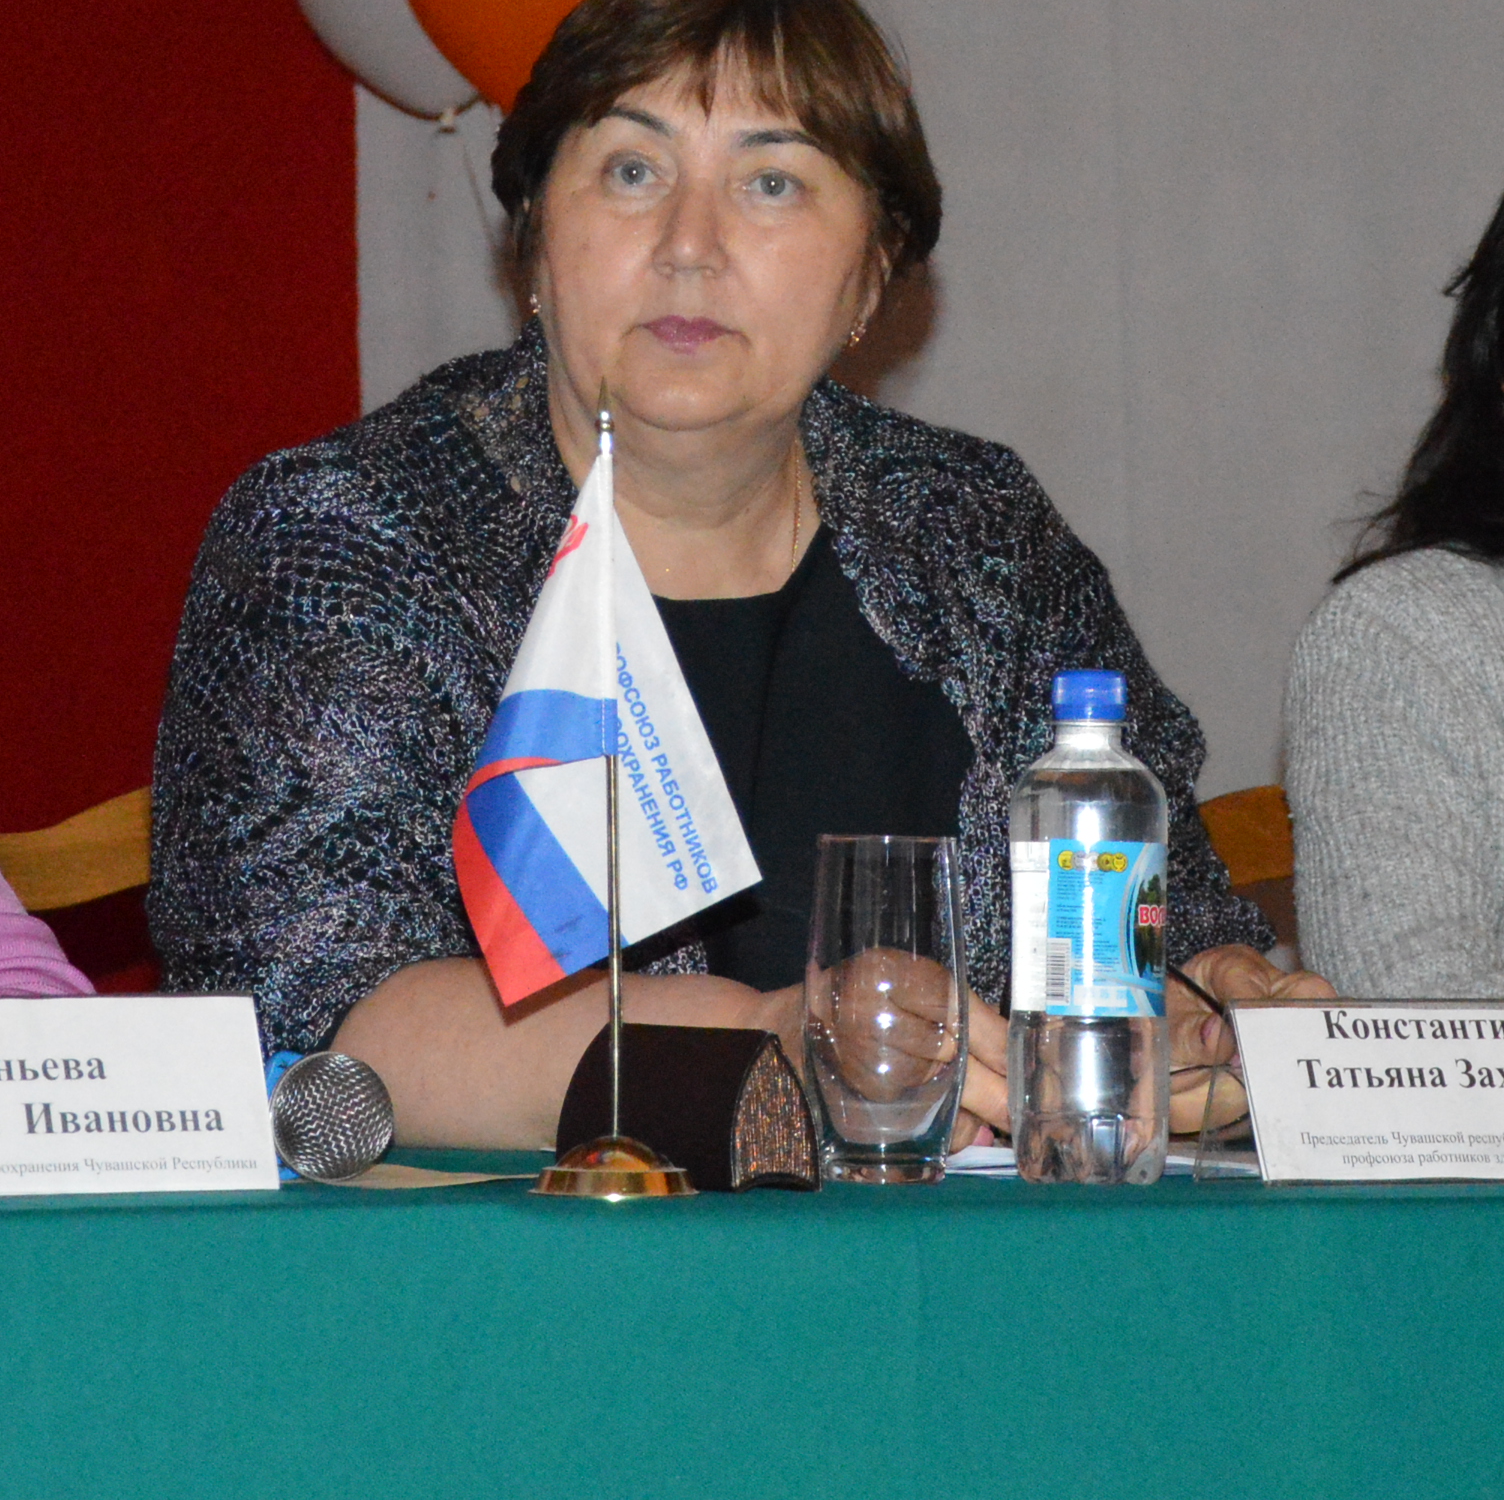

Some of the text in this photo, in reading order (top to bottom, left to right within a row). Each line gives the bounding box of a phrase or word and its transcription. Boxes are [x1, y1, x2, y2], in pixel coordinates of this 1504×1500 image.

[616, 641, 718, 895] ОФСОЮЗ РАБОТНИКОВ
[666, 858, 689, 891] РФ
[1296, 1058, 1448, 1089] Татьяна
[23, 1102, 225, 1135] Ивановна
[1300, 1131, 1389, 1148] Председатель
[1390, 1131, 1466, 1148] Чувашской
[83, 1157, 168, 1176] Чувашской
[171, 1155, 258, 1173] Республики
[1342, 1151, 1415, 1168] профсоюза
[1417, 1149, 1492, 1167] работников
